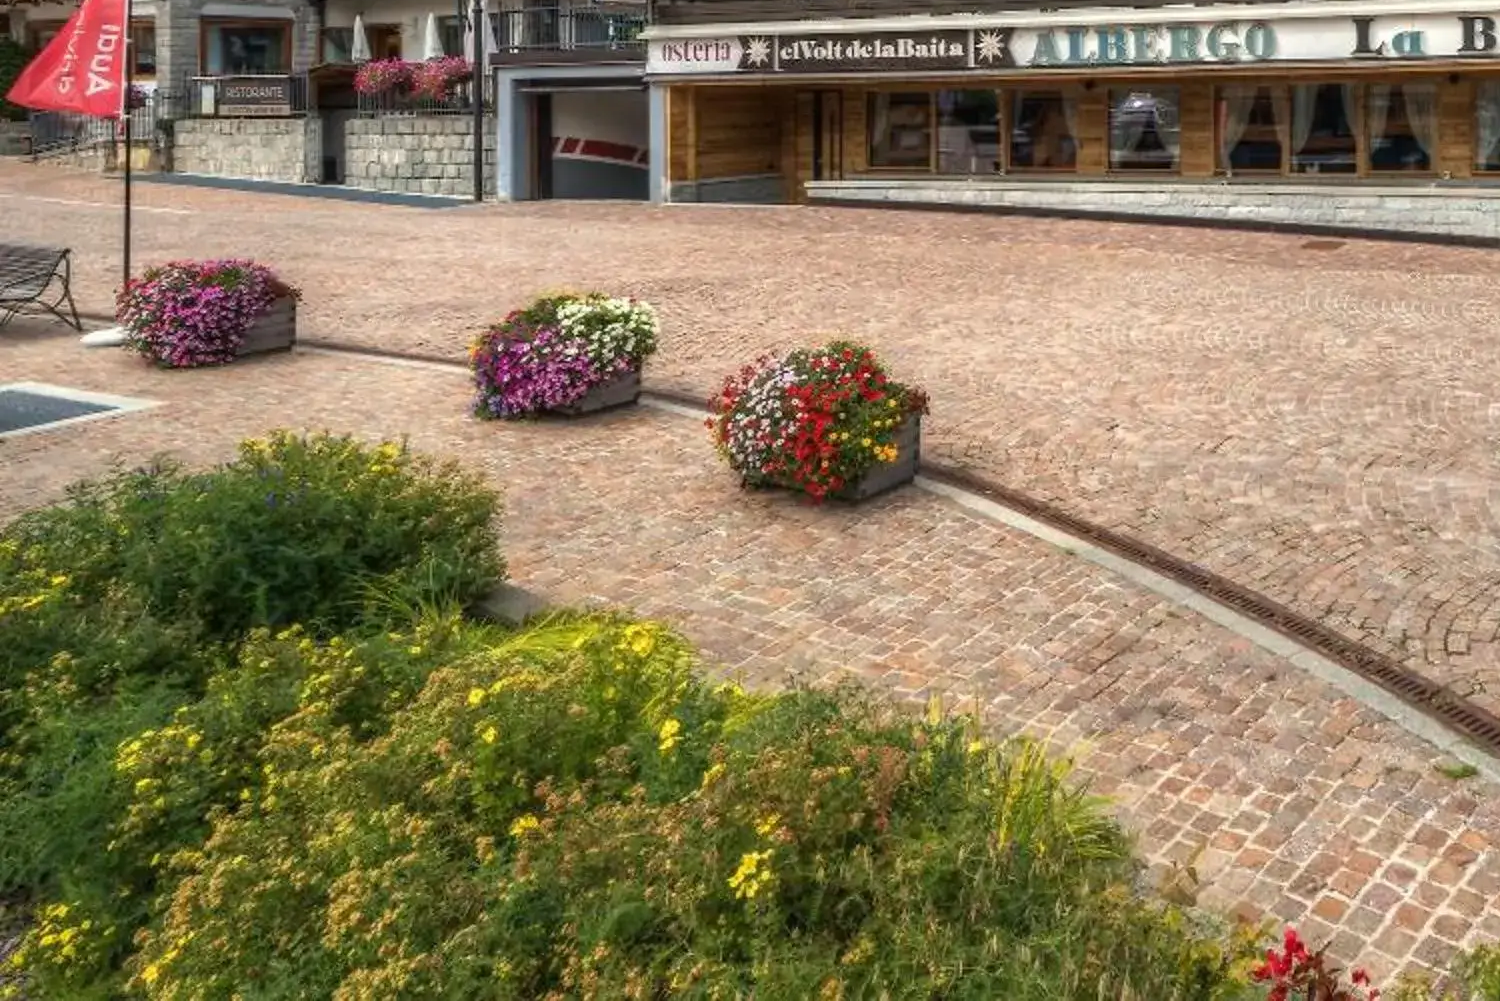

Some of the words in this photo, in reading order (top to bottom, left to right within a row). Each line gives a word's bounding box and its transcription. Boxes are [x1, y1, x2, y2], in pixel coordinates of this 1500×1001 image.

[662, 40, 730, 62] osteria
[1028, 22, 1278, 66] ALBERGO
[1350, 15, 1425, 56] La
